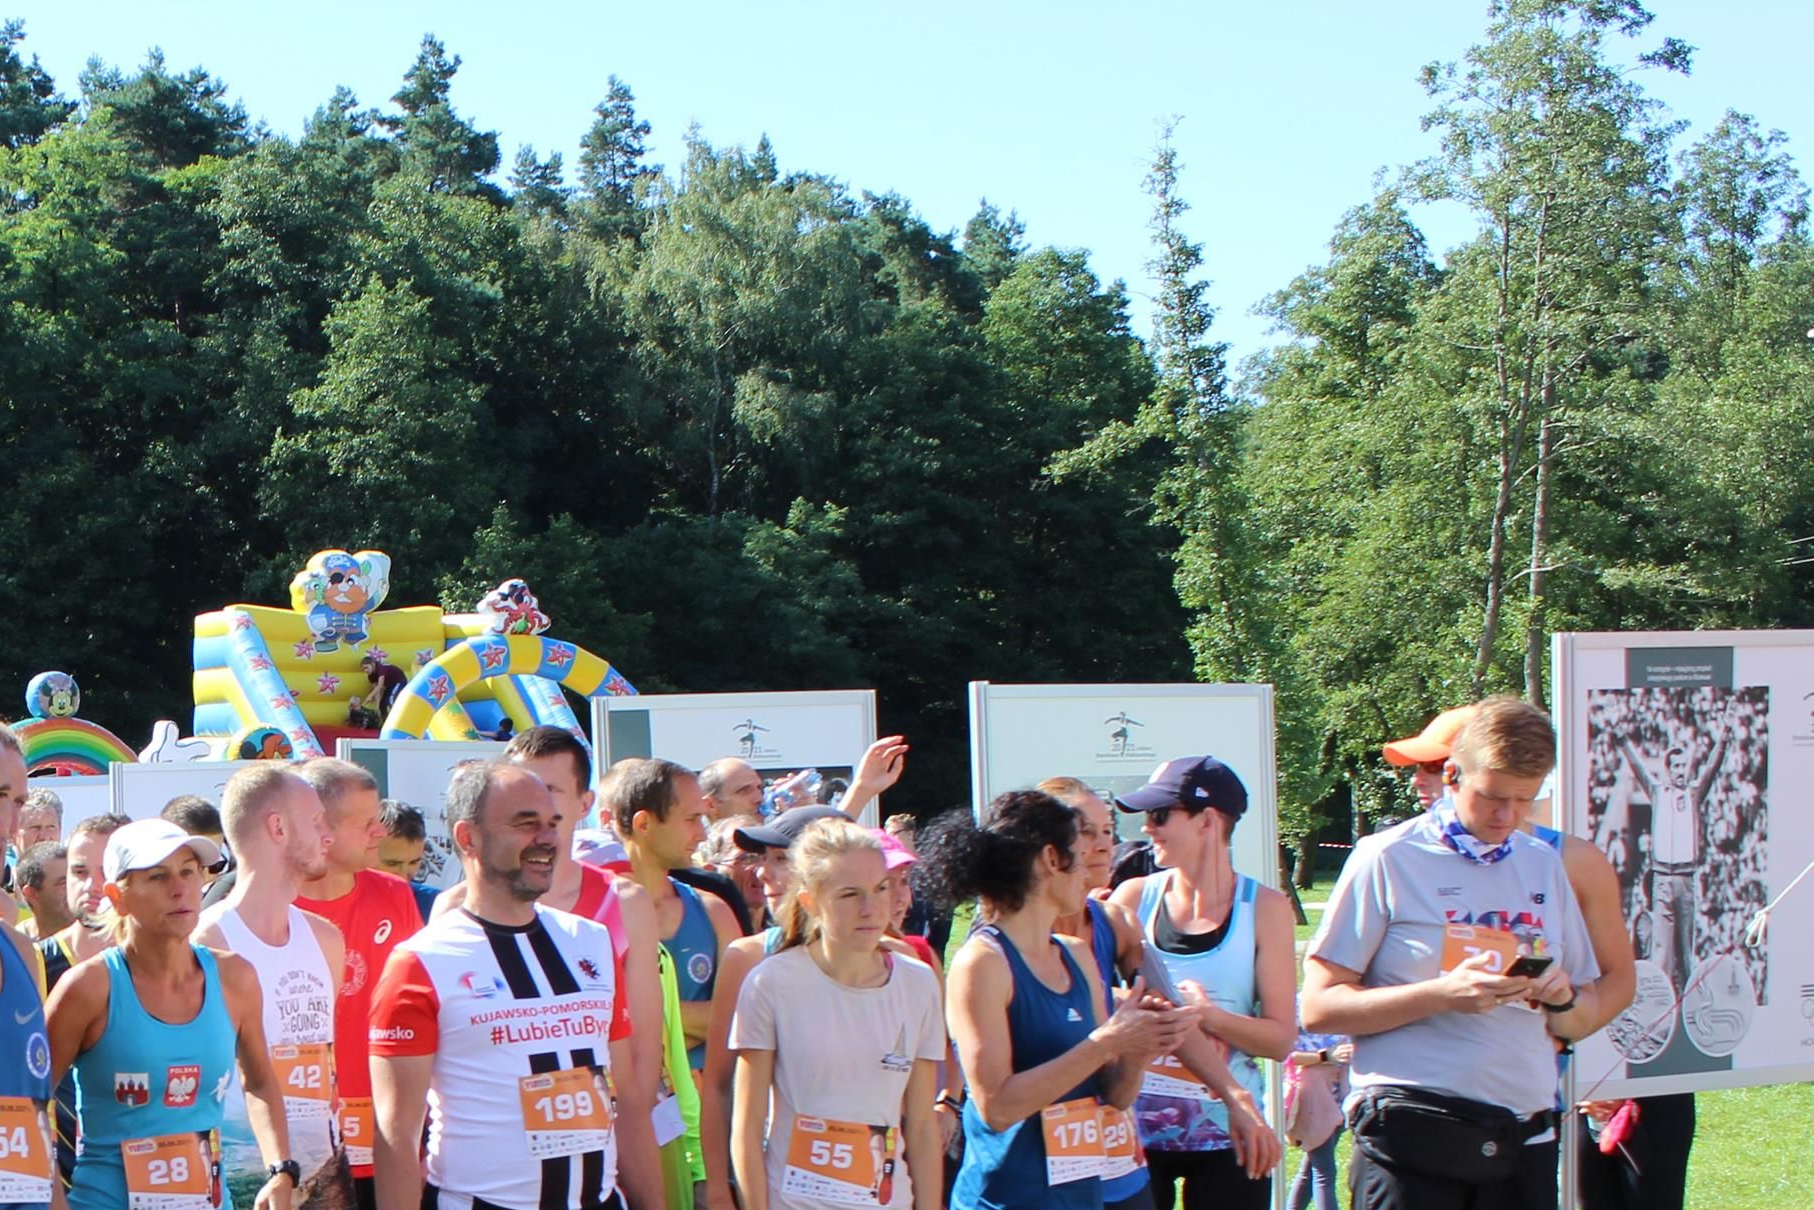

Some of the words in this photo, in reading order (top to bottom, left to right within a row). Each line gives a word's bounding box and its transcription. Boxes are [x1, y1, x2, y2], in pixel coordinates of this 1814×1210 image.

[275, 997, 300, 1020] YOU
[307, 997, 330, 1016] ARE
[289, 1013, 321, 1033] GOING
[169, 1066, 199, 1075] POLSKA
[288, 1065, 322, 1089] 42
[534, 1090, 594, 1122] 199
[343, 1116, 361, 1138] 5
[1053, 1119, 1098, 1149] 176
[1103, 1122, 1129, 1149] 29
[809, 1139, 853, 1169] 55
[147, 1156, 189, 1185] 28
